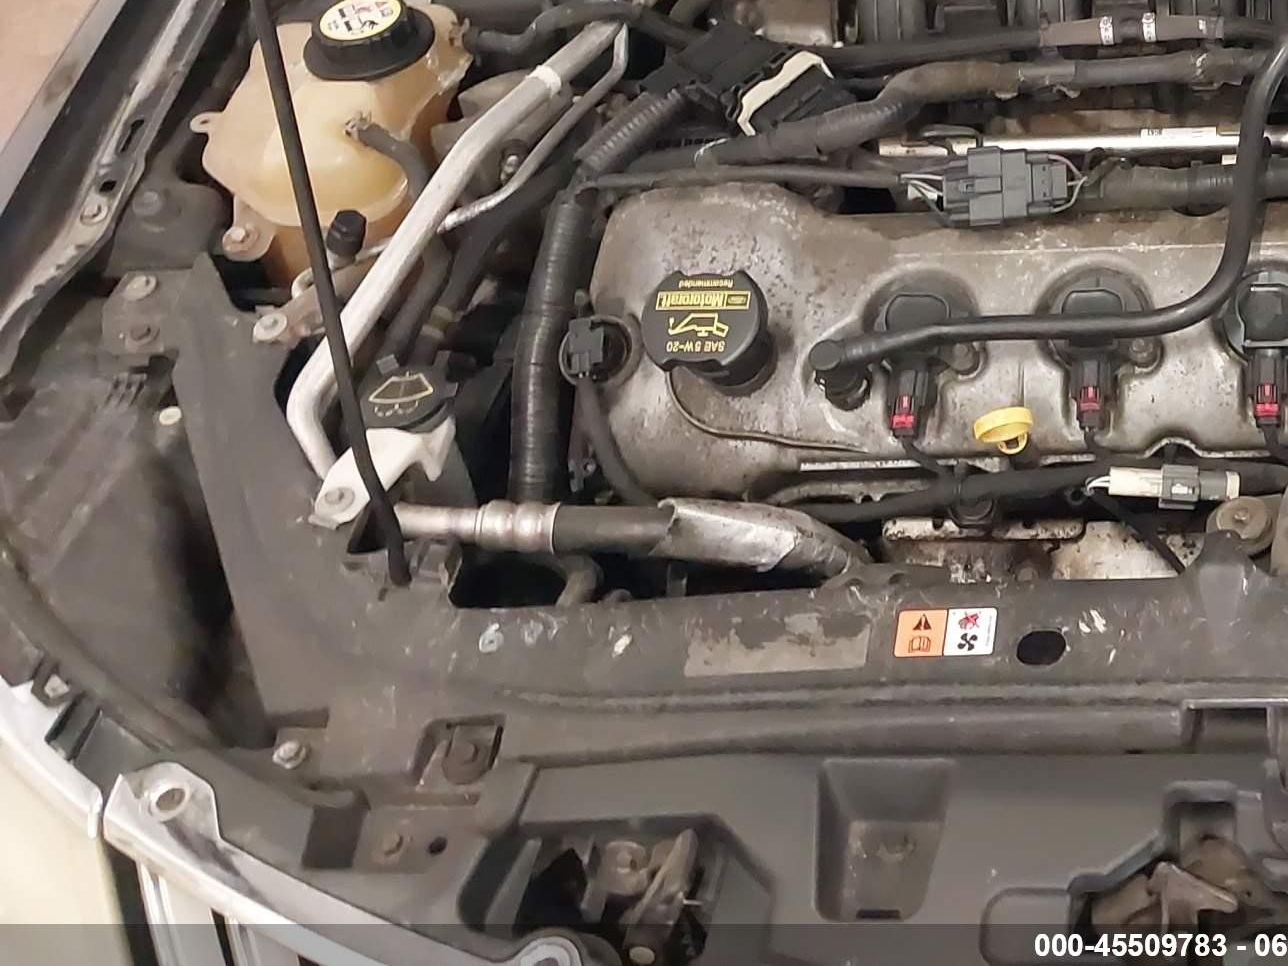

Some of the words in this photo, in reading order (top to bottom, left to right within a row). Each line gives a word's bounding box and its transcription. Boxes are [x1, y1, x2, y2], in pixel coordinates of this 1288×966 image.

[678, 279, 733, 288] Recommended
[666, 340, 702, 352] 5W-20
[704, 340, 726, 352] SAE
